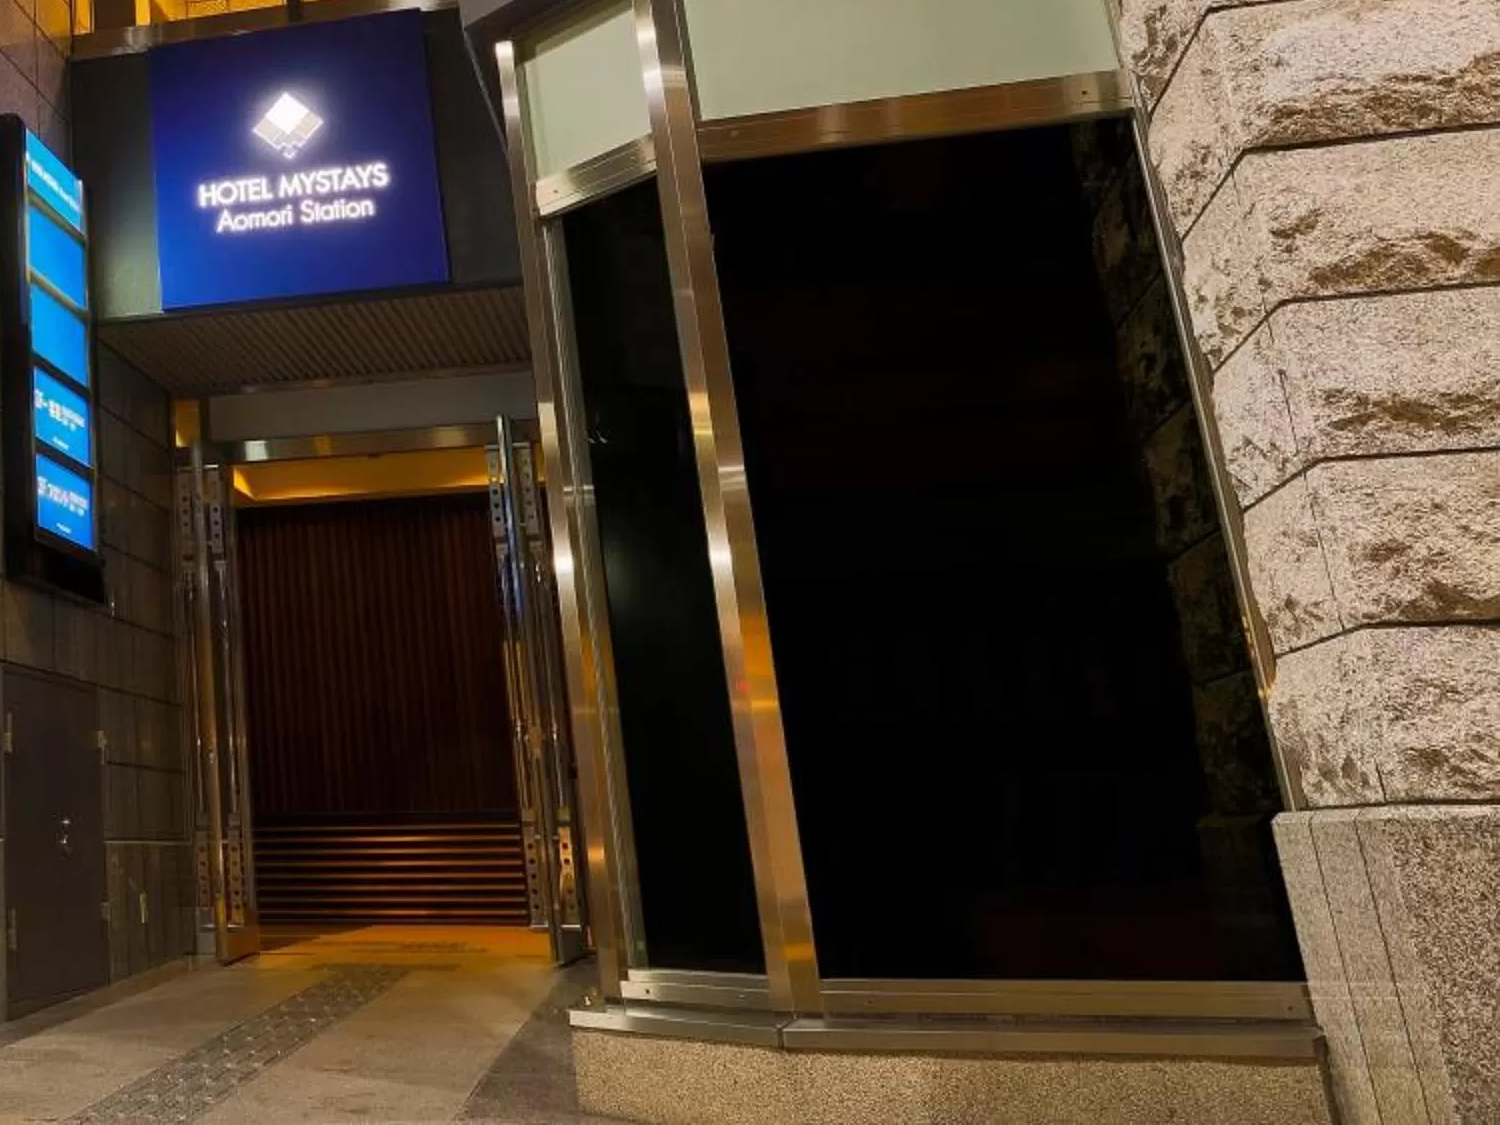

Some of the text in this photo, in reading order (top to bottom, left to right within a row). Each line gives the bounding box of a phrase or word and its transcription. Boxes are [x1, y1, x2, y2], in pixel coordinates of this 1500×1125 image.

[198, 162, 390, 209] HOTEL MYSTAYS
[216, 198, 376, 233] Aomori Station
